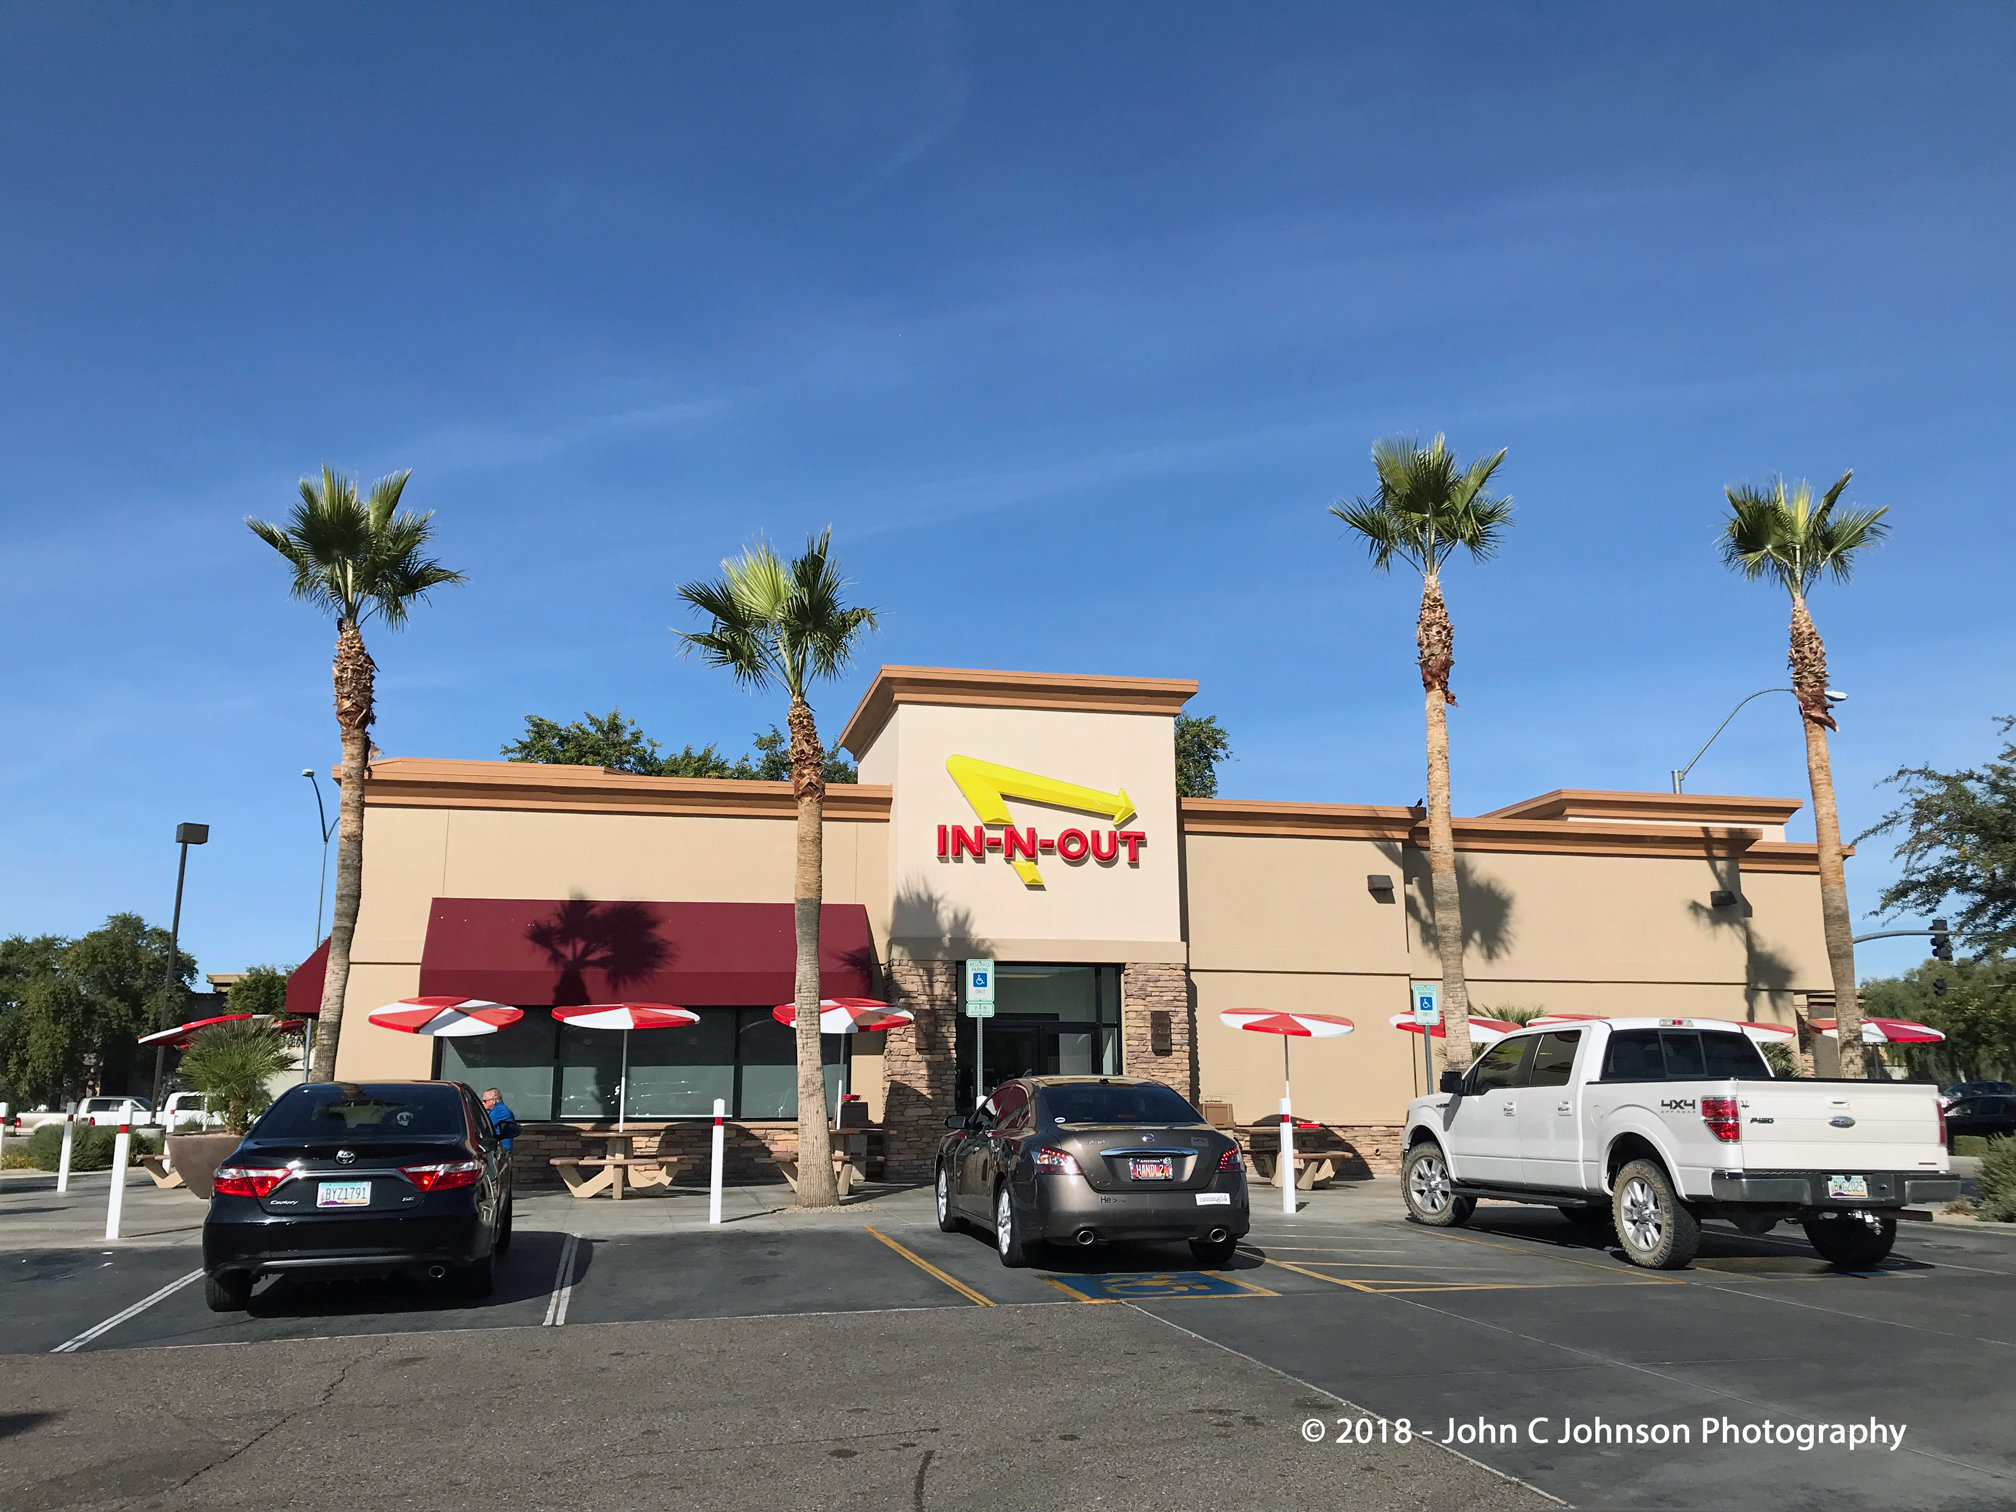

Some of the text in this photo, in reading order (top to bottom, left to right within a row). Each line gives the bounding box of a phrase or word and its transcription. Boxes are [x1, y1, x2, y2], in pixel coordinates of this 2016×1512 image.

[937, 824, 1146, 864] IN-N-OUT
[325, 1187, 367, 1201] BYZ1791
[1100, 1195, 1111, 1204] He
